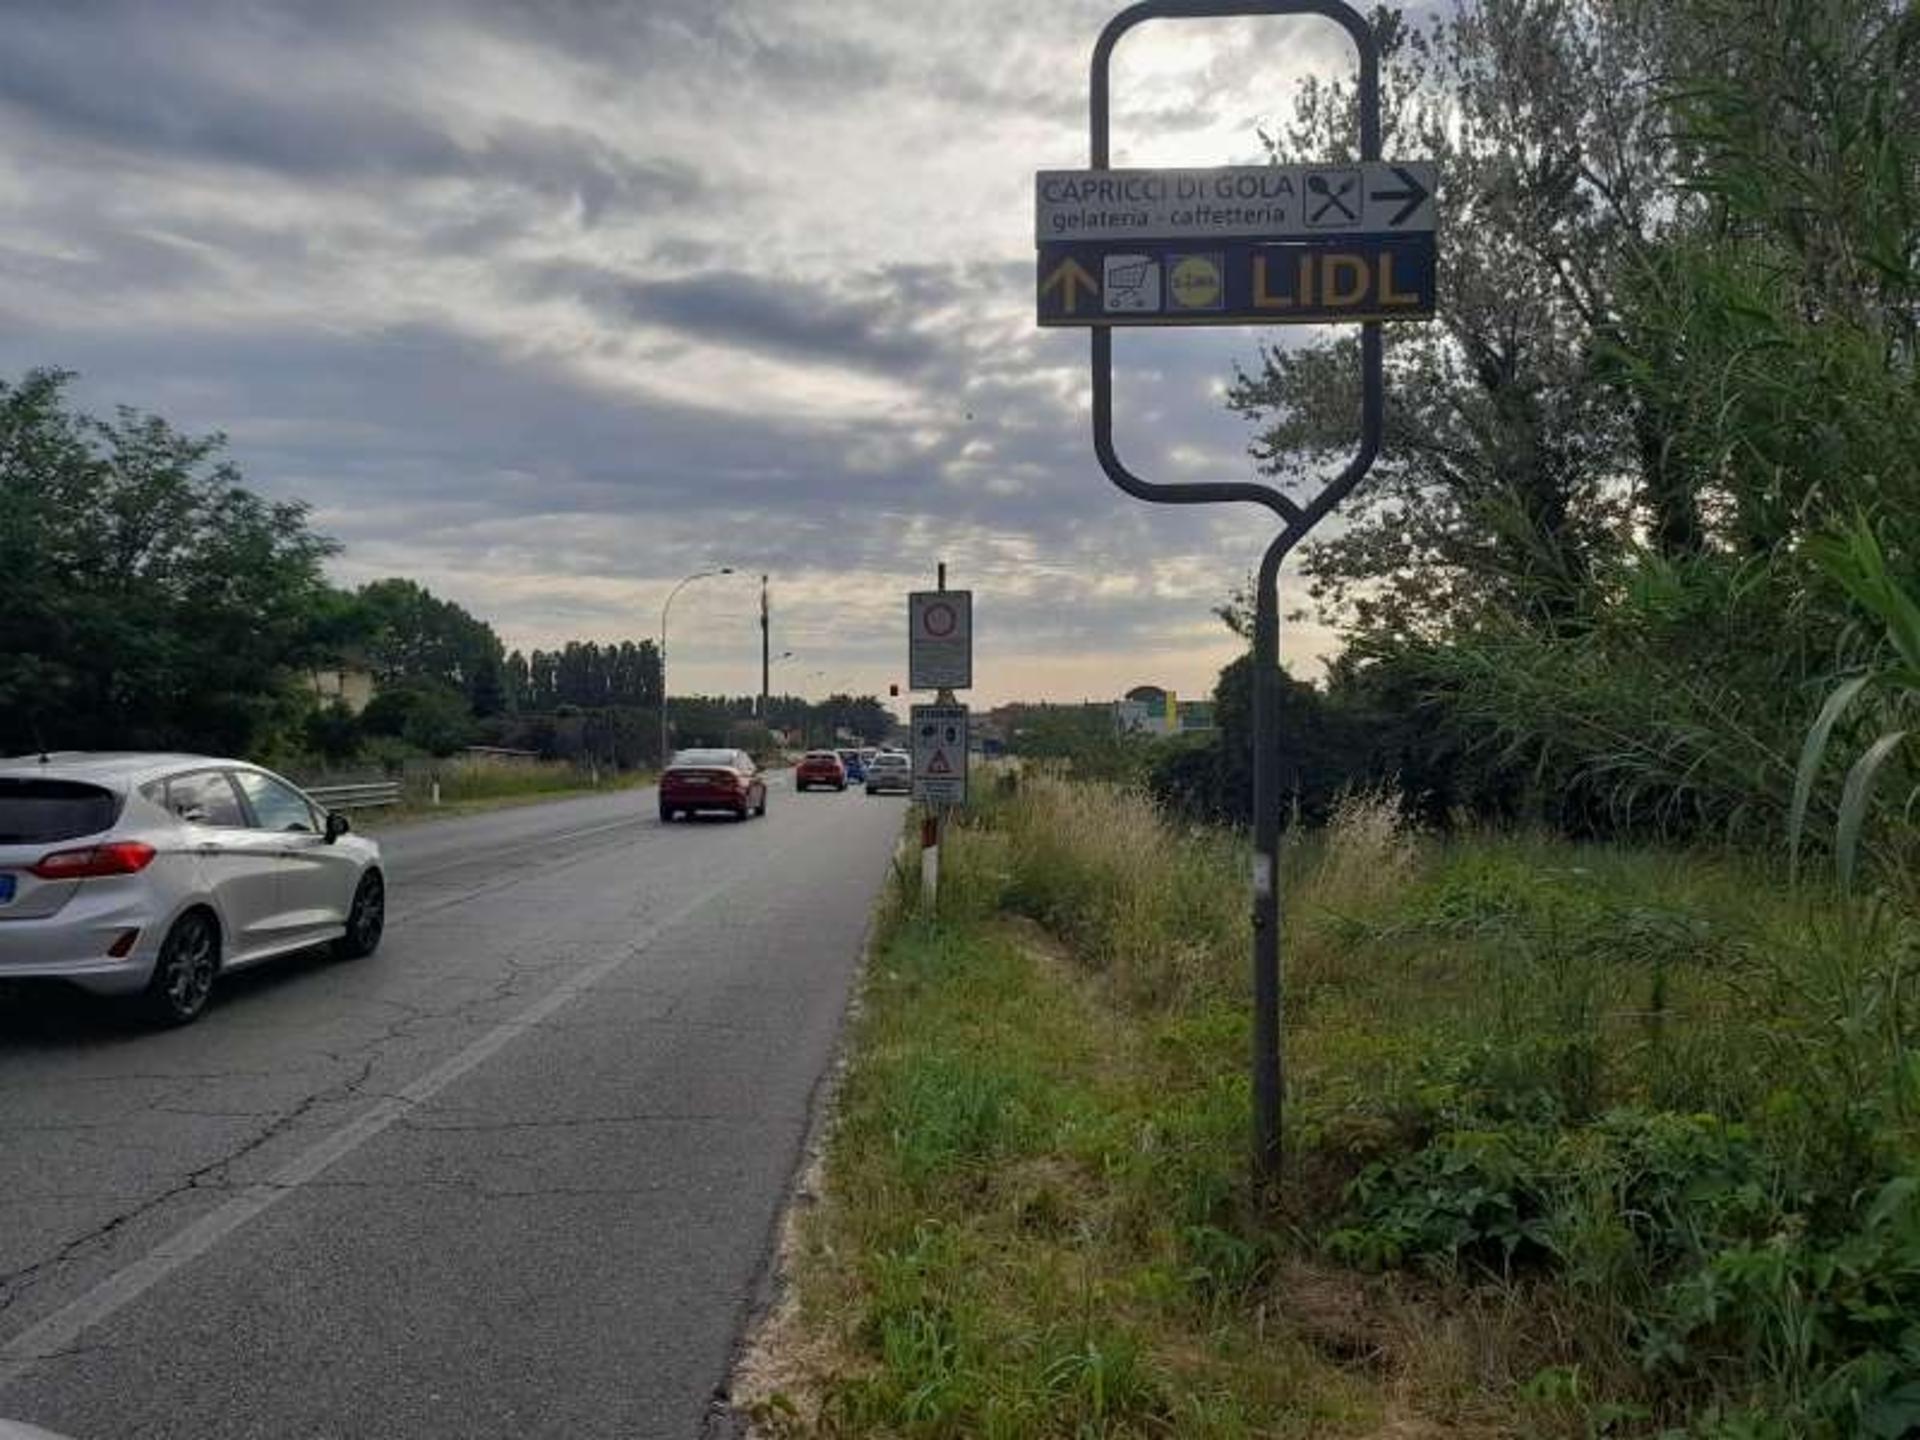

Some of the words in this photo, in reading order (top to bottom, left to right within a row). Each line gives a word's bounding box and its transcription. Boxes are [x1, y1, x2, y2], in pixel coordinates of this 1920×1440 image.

[1043, 177, 1167, 203] CAPRICCI
[1177, 175, 1205, 200] DI
[1216, 174, 1295, 200] GOLA
[1053, 209, 1148, 233] gelateria
[1170, 205, 1286, 228] caffetteria
[1252, 251, 1419, 307] LIDL
